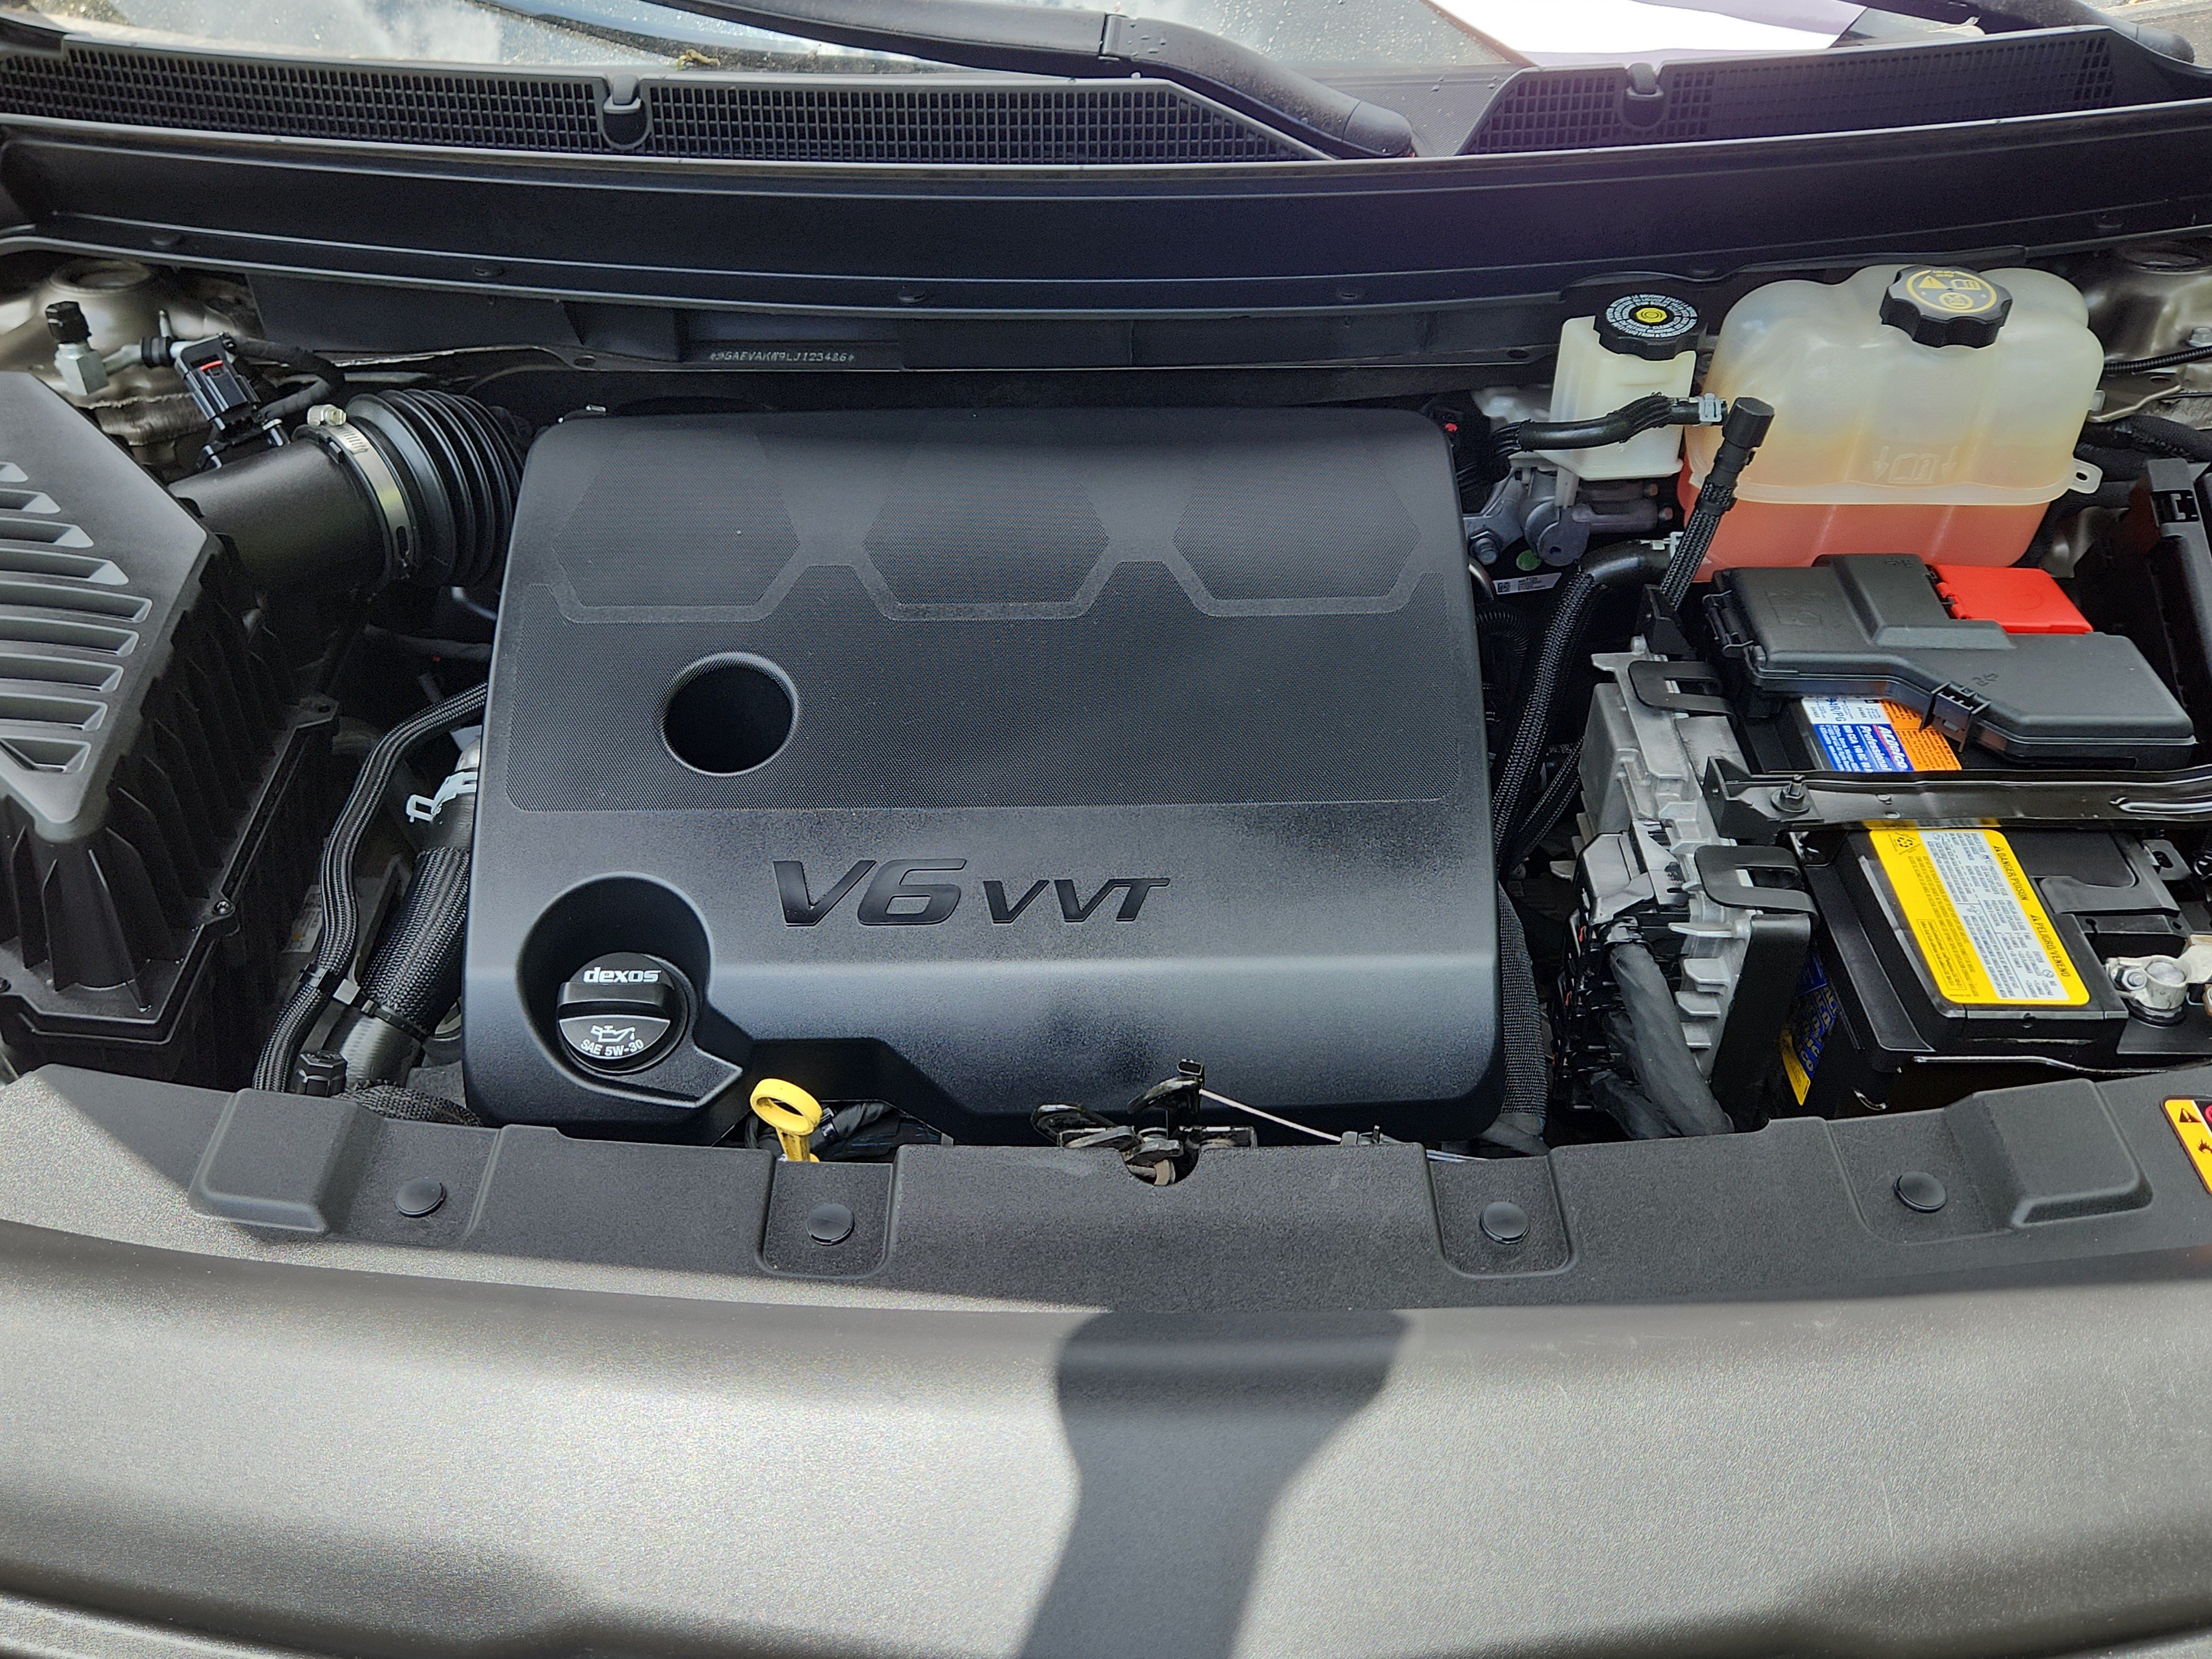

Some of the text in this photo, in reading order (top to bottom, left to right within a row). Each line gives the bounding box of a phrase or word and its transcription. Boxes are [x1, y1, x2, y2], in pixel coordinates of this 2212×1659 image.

[1860, 725, 1892, 771] Professional
[773, 858, 1171, 927] V6 VVT
[583, 967, 661, 983] dexos
[581, 1039, 644, 1056] SAE 5W-30
